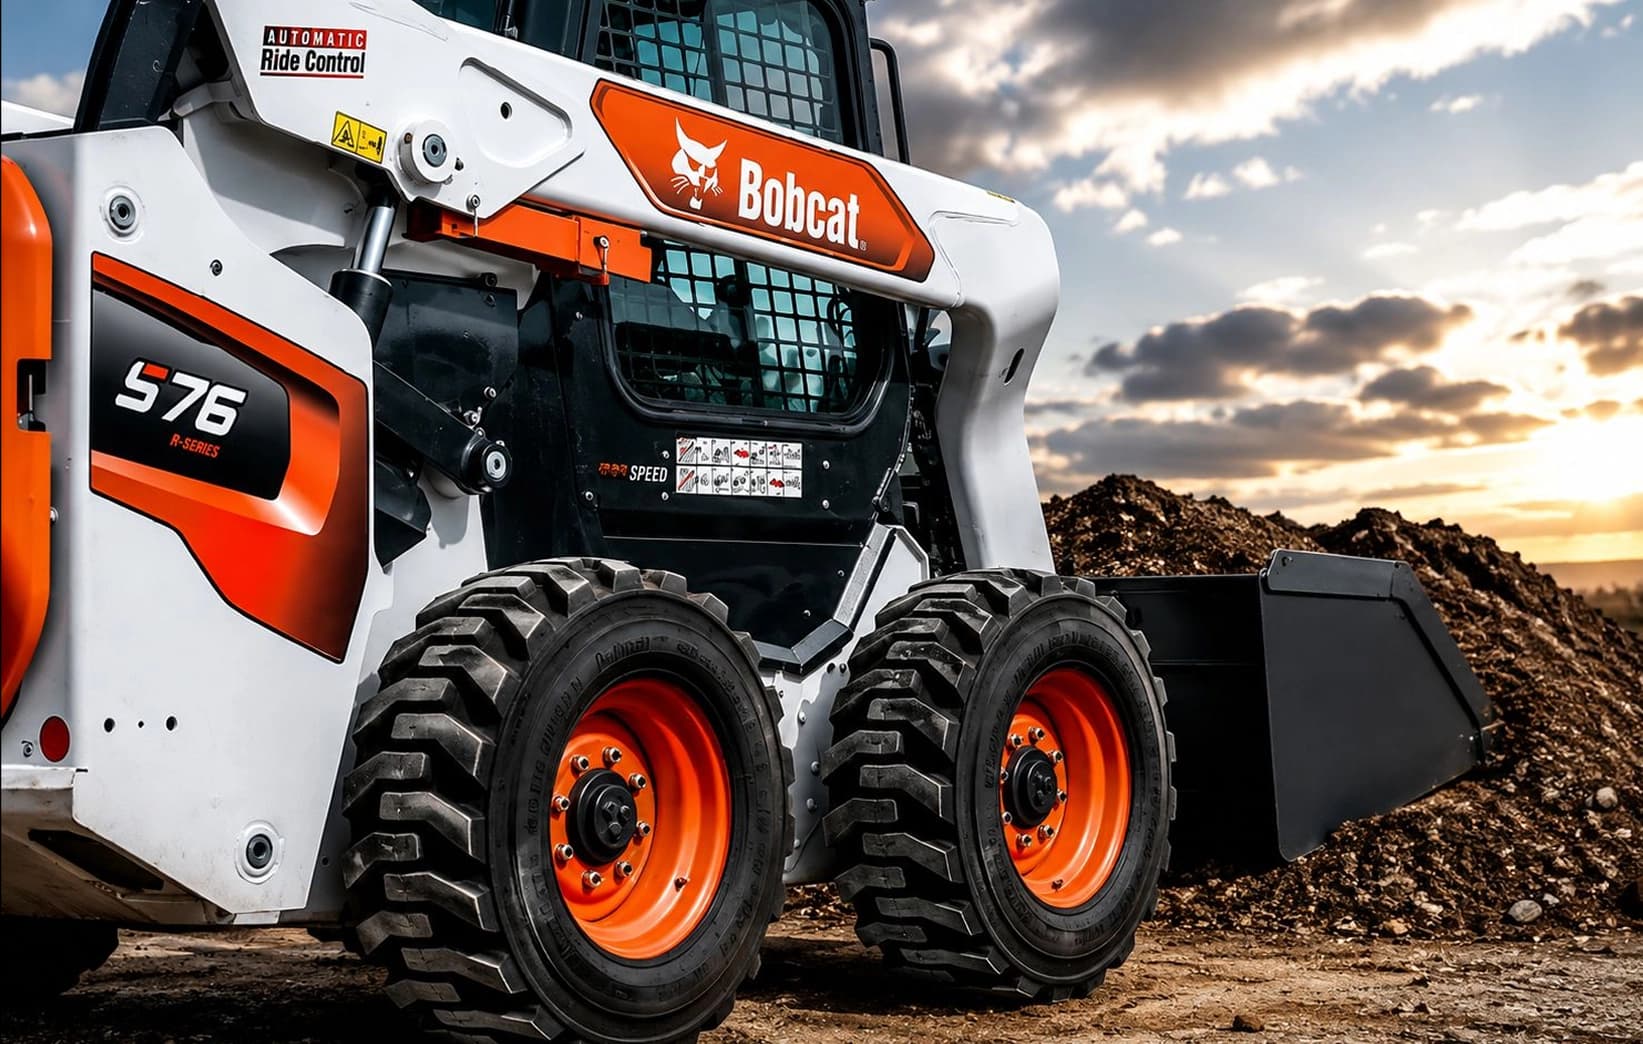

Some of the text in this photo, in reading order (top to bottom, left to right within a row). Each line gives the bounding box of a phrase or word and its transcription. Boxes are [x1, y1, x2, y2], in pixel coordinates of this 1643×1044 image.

[267, 29, 364, 48] AUTOMATIC
[260, 48, 366, 73] Ride Control
[738, 157, 861, 250] Bobcat
[115, 360, 247, 436] S76
[169, 433, 221, 458] R-SERIES
[629, 464, 668, 482] SPEED
